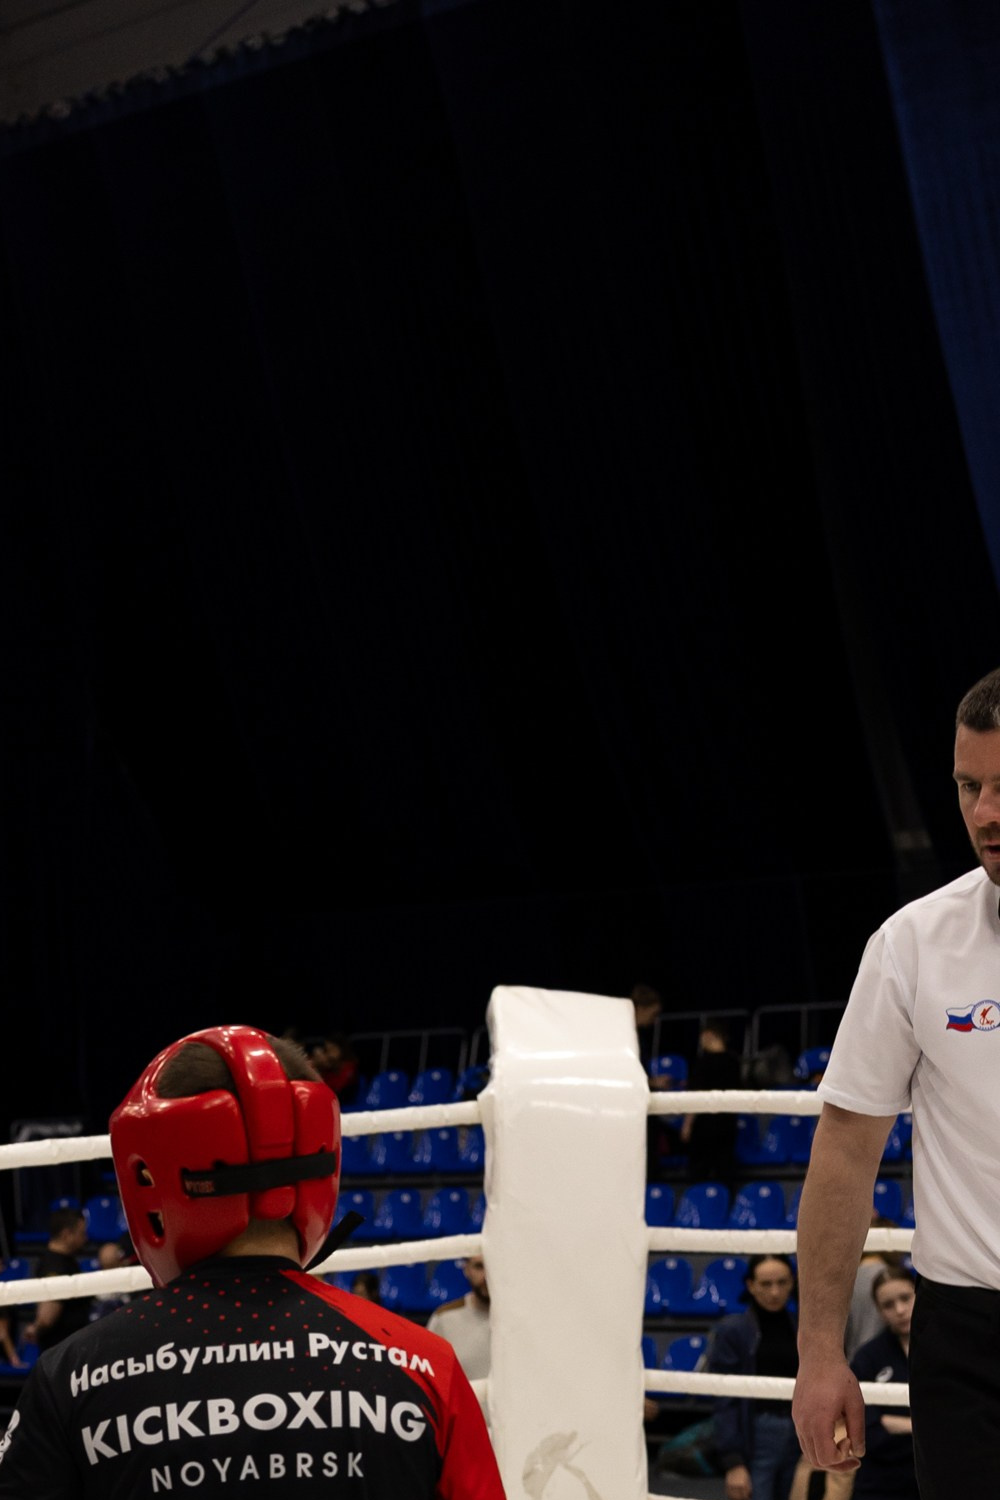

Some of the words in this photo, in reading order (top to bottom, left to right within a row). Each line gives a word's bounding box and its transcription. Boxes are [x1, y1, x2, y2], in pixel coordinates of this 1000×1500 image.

[70, 1340, 295, 1397] Насыбуллин
[308, 1332, 435, 1378] Рустам
[81, 1390, 426, 1466] KICKBOXING
[151, 1452, 364, 1493] NOYABRSK
